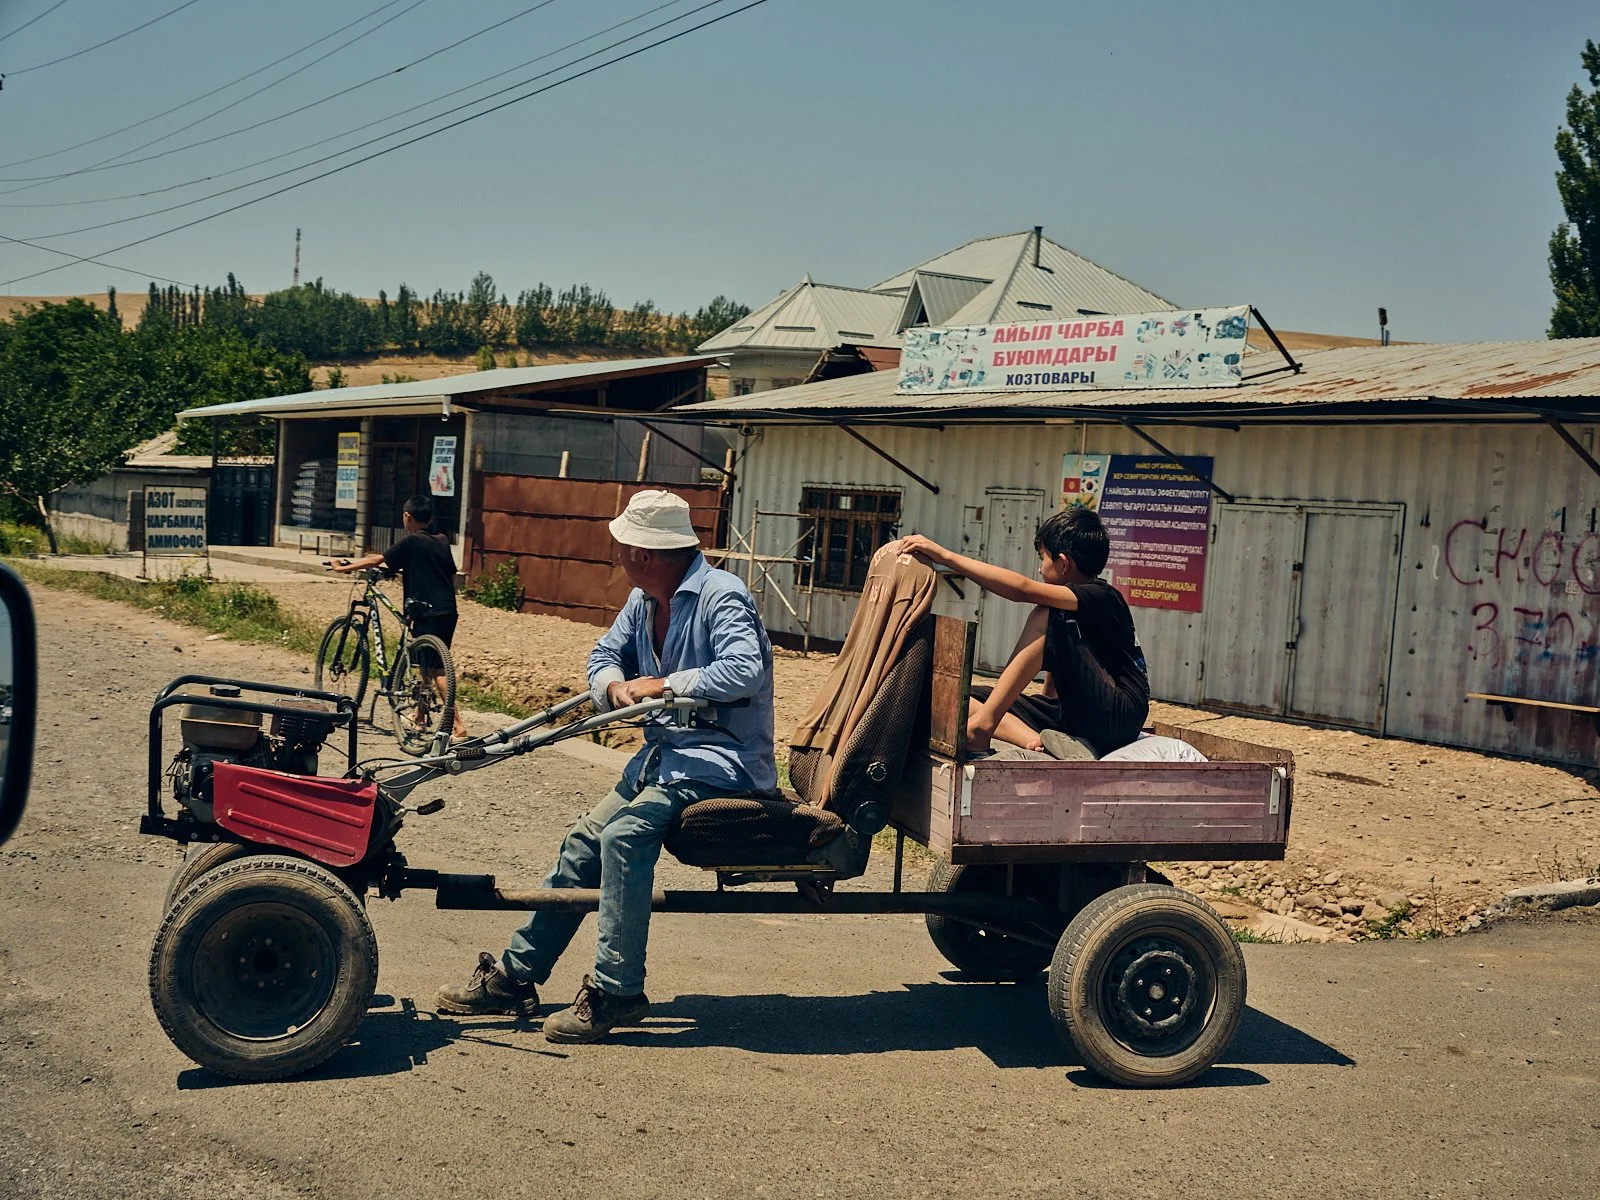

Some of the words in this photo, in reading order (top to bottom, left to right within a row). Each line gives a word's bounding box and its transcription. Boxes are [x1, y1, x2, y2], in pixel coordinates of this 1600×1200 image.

[992, 323, 1053, 344] АЙЫЛ
[1057, 319, 1125, 341] ЧАРБА
[992, 345, 1118, 367] БУЮМДАРЫ
[1005, 371, 1096, 386] ХОЗТОВАРЫ
[147, 492, 175, 508] АЗОТ
[147, 515, 204, 530] КАРБАМИД
[147, 534, 204, 548] АММОФОС
[370, 610, 385, 665] GALAXY
